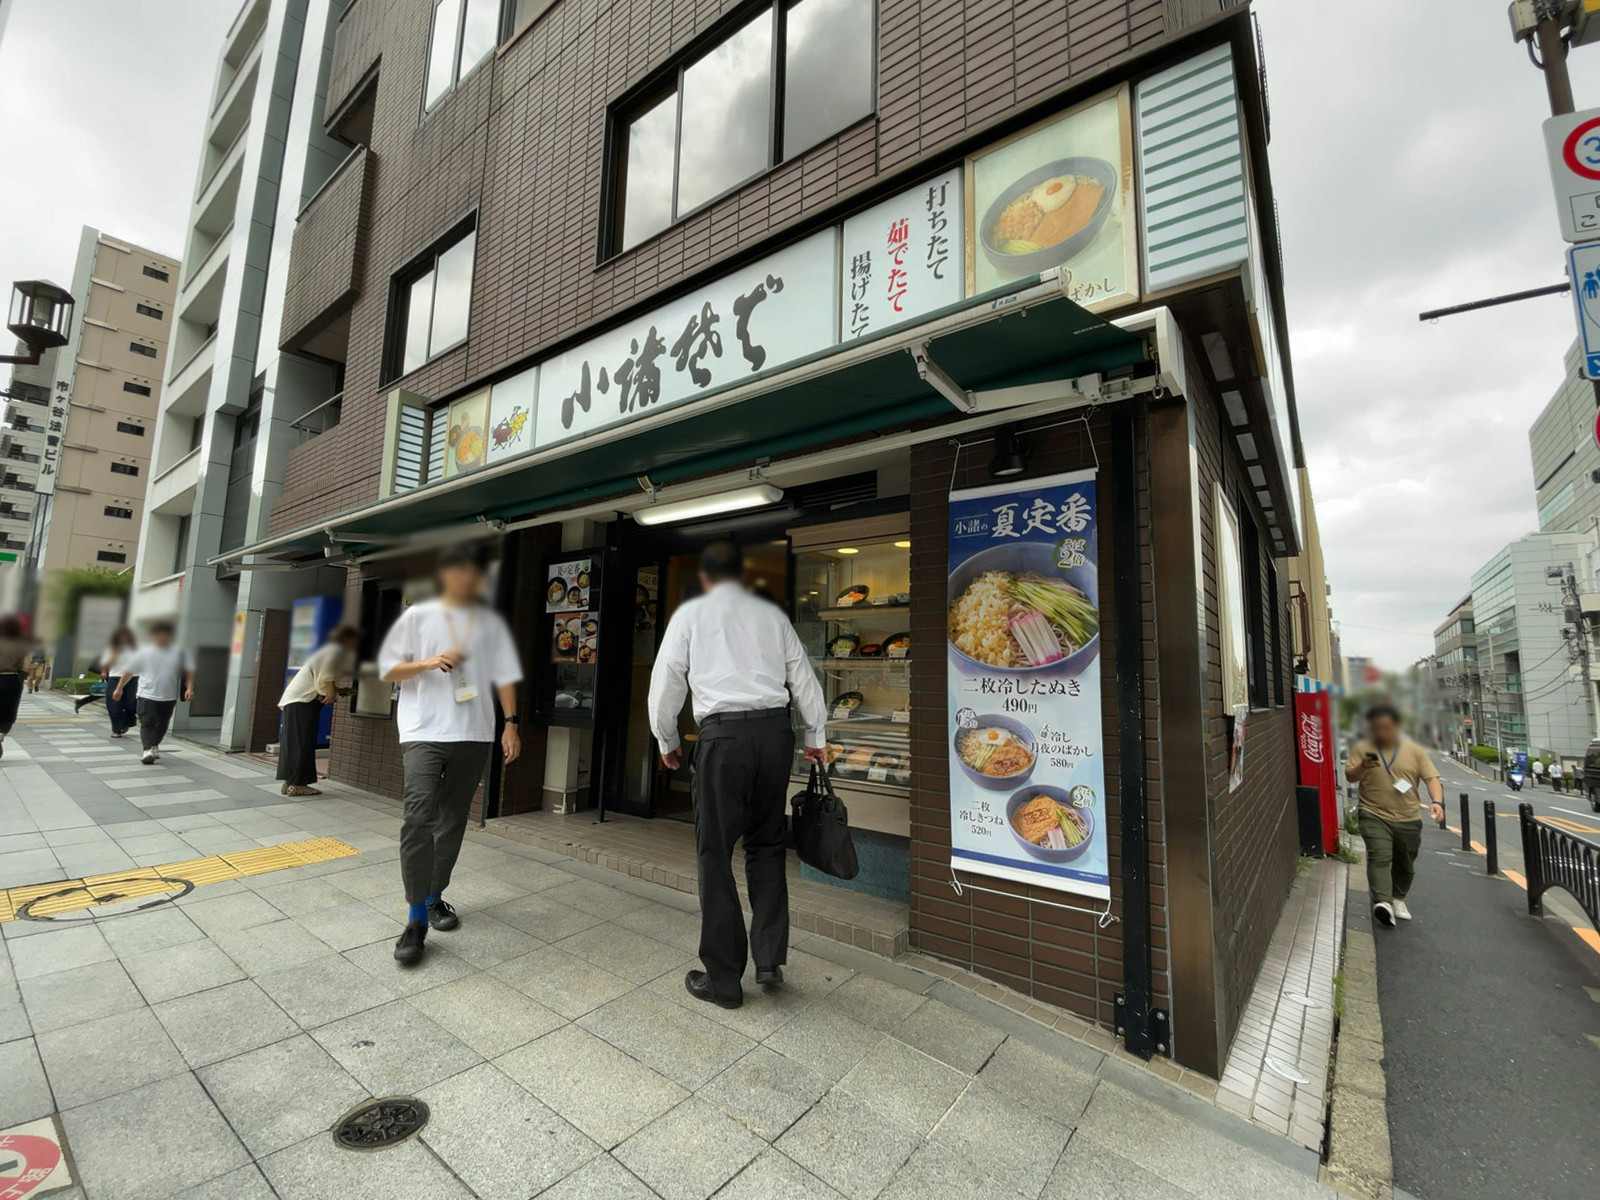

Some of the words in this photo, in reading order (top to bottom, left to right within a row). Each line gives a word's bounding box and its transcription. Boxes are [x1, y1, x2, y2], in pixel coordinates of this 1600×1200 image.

[926, 181, 950, 280] 打ちたて
[887, 217, 910, 312] 茹でたて
[850, 250, 872, 337] 揚げたて
[954, 519, 988, 534] 小諸の
[991, 492, 1092, 538] 夏定番
[1057, 549, 1086, 568] 2倍
[963, 677, 1081, 697] 二枚冷したぬき
[1002, 698, 1038, 713] 490円
[1050, 731, 1071, 743] 冷し
[1030, 742, 1093, 757] 月夜のばかし
[1050, 758, 1074, 769] 580円
[971, 800, 990, 812] 二枚
[960, 810, 1004, 825] 冷しきつね
[971, 825, 992, 837] 520円
